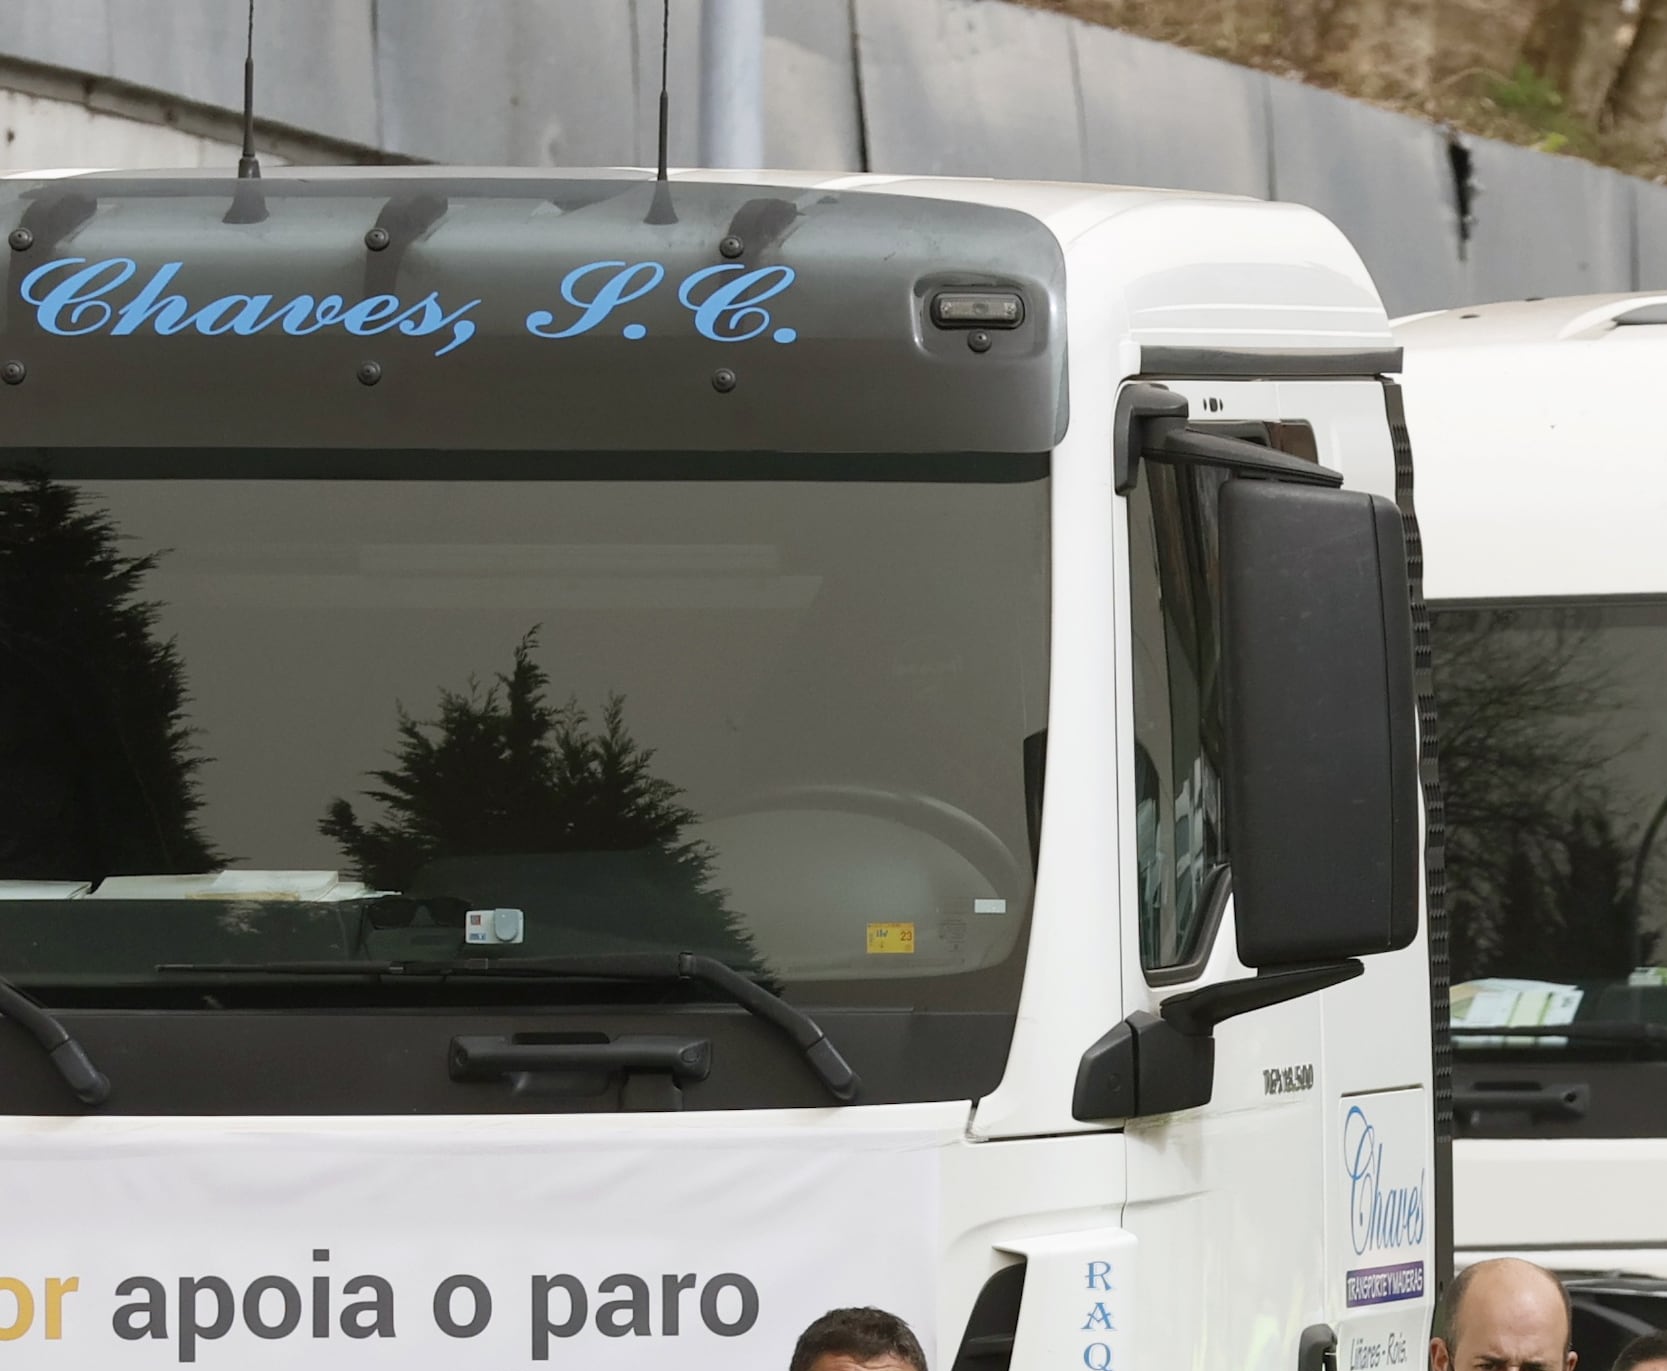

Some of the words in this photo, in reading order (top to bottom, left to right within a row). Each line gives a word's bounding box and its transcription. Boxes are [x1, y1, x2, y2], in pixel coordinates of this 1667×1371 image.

[20, 256, 481, 356] Chaves,
[1344, 1105, 1425, 1256] Chaves
[111, 1248, 396, 1364] apoia
[432, 1273, 493, 1340] o
[530, 1271, 760, 1361] paro
[1347, 1274, 1387, 1301] TRANSPORTE
[1392, 1267, 1424, 1296] MADERAS
